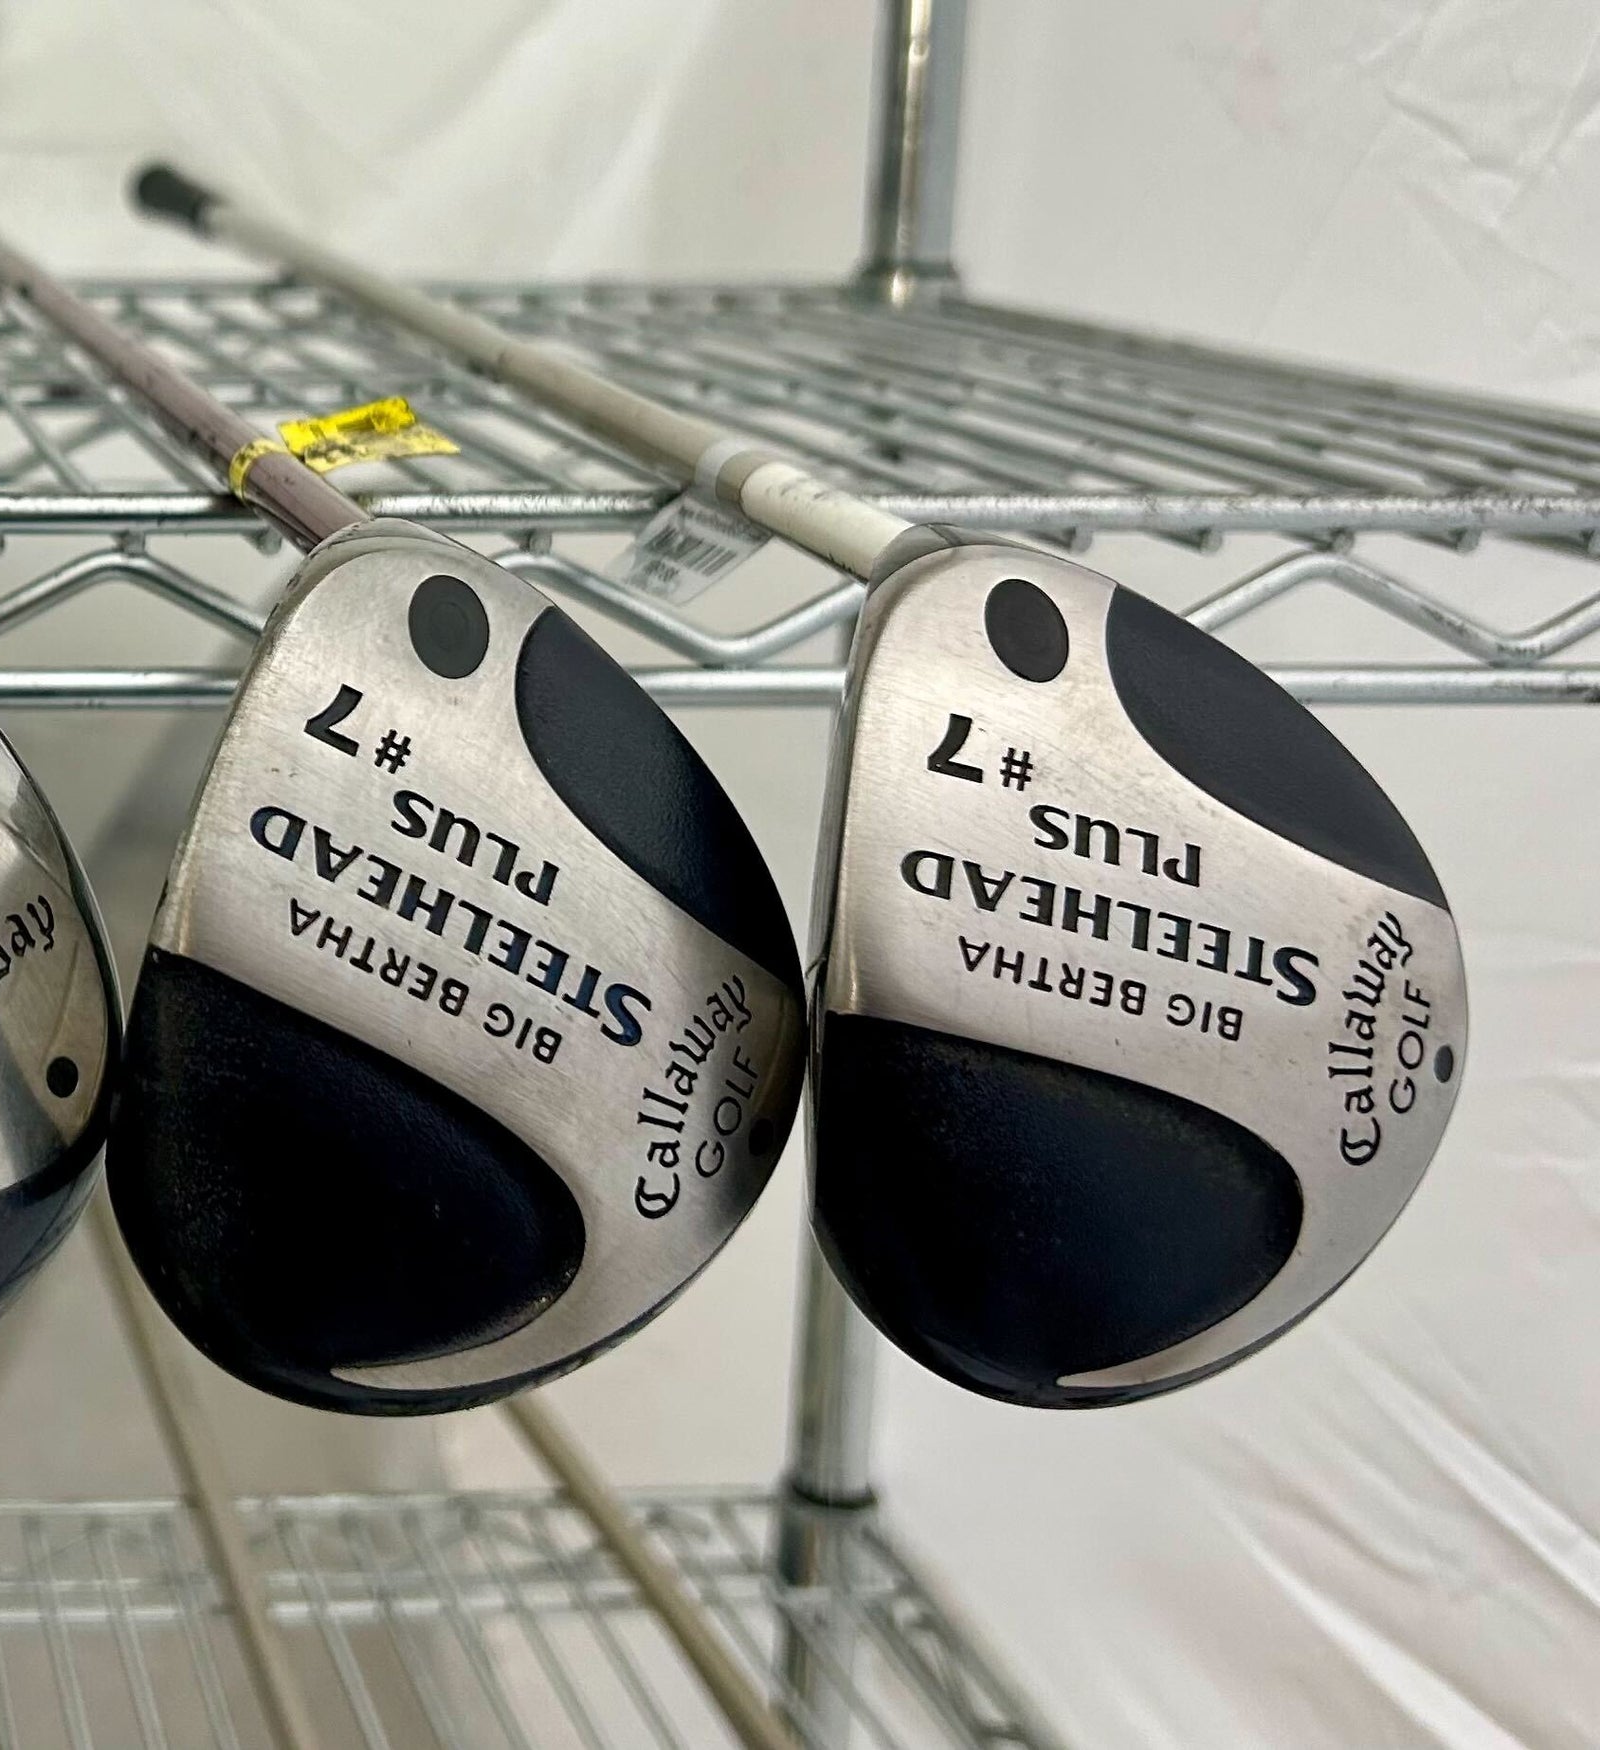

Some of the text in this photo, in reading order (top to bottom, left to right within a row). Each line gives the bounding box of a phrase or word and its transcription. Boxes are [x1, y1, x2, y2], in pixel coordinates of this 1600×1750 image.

[391, 789, 560, 907] PLUS
[1028, 803, 1201, 888] PLUS
[249, 805, 653, 1047] STEELHEAD
[288, 897, 563, 1065] BIG BERTHA
[899, 849, 1319, 1006] STEELHEAD
[957, 935, 1244, 1042] BIG BERTHA
[634, 974, 754, 1219] Callaway
[1328, 910, 1415, 1166] Callaway
[1388, 980, 1434, 1114] GOLF
[694, 1045, 759, 1178] GOLF
